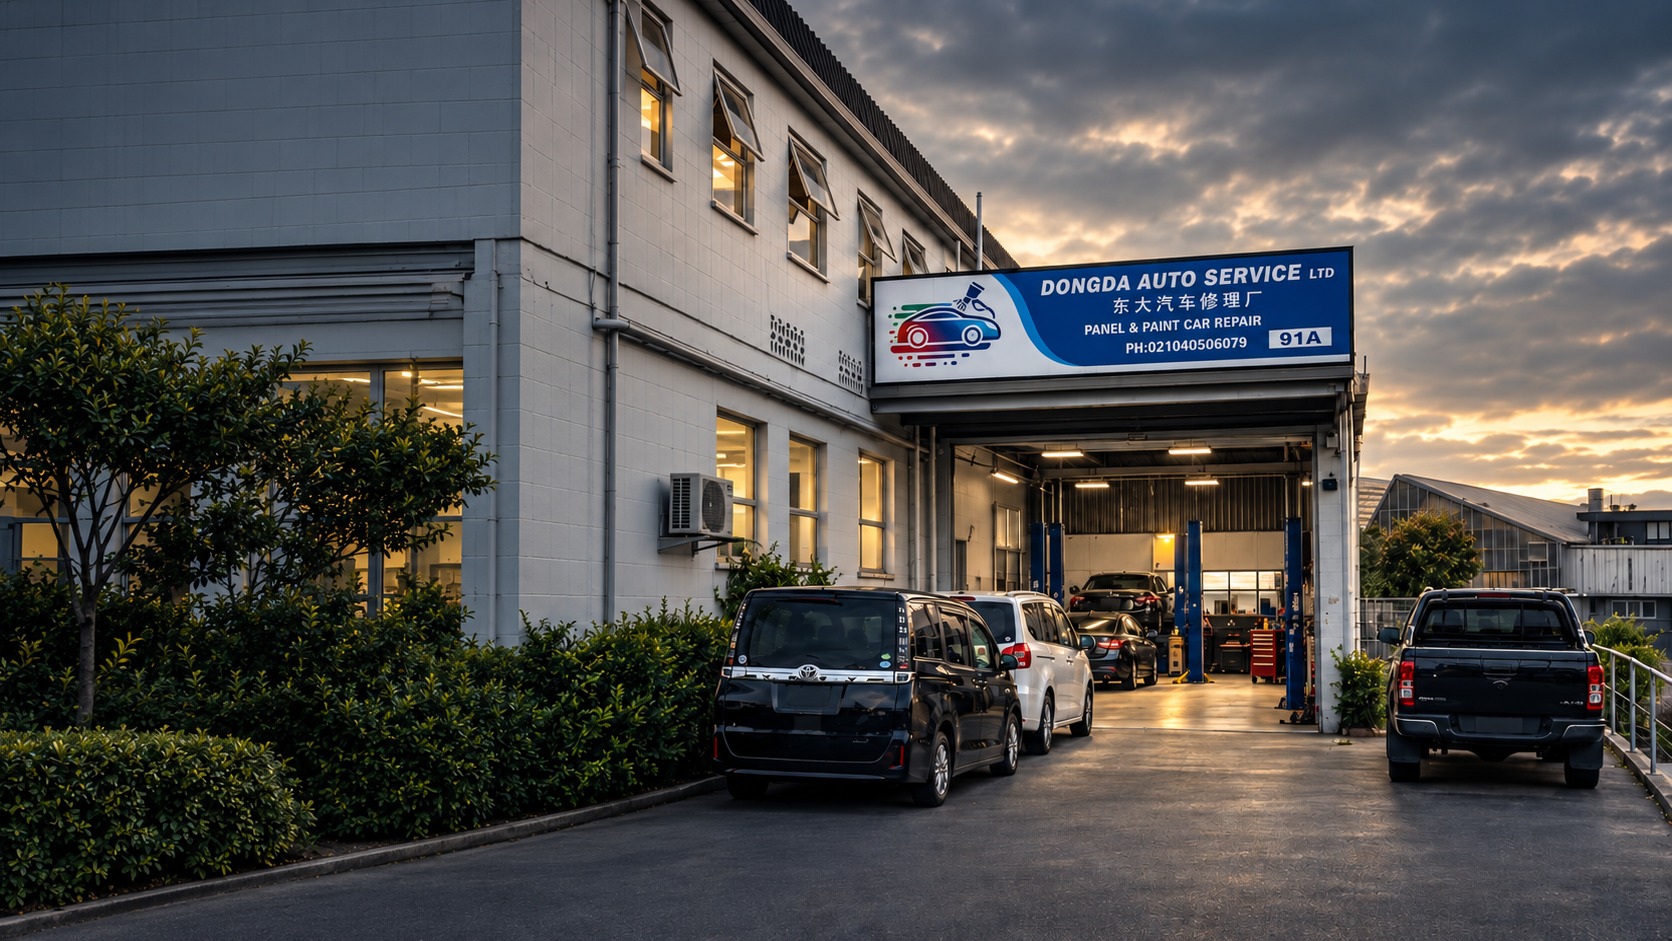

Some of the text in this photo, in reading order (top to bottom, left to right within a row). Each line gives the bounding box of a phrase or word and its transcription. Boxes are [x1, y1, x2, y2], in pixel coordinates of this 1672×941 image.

[1041, 264, 1334, 296] DONGDA AUTO SERVICE LTD
[1113, 291, 1262, 314] 东大汽车修理厂
[1085, 316, 1261, 335] PANEL & PAINT CAR REPAIR
[1126, 337, 1247, 354] PH:021040506079
[1280, 331, 1321, 345] 91A
